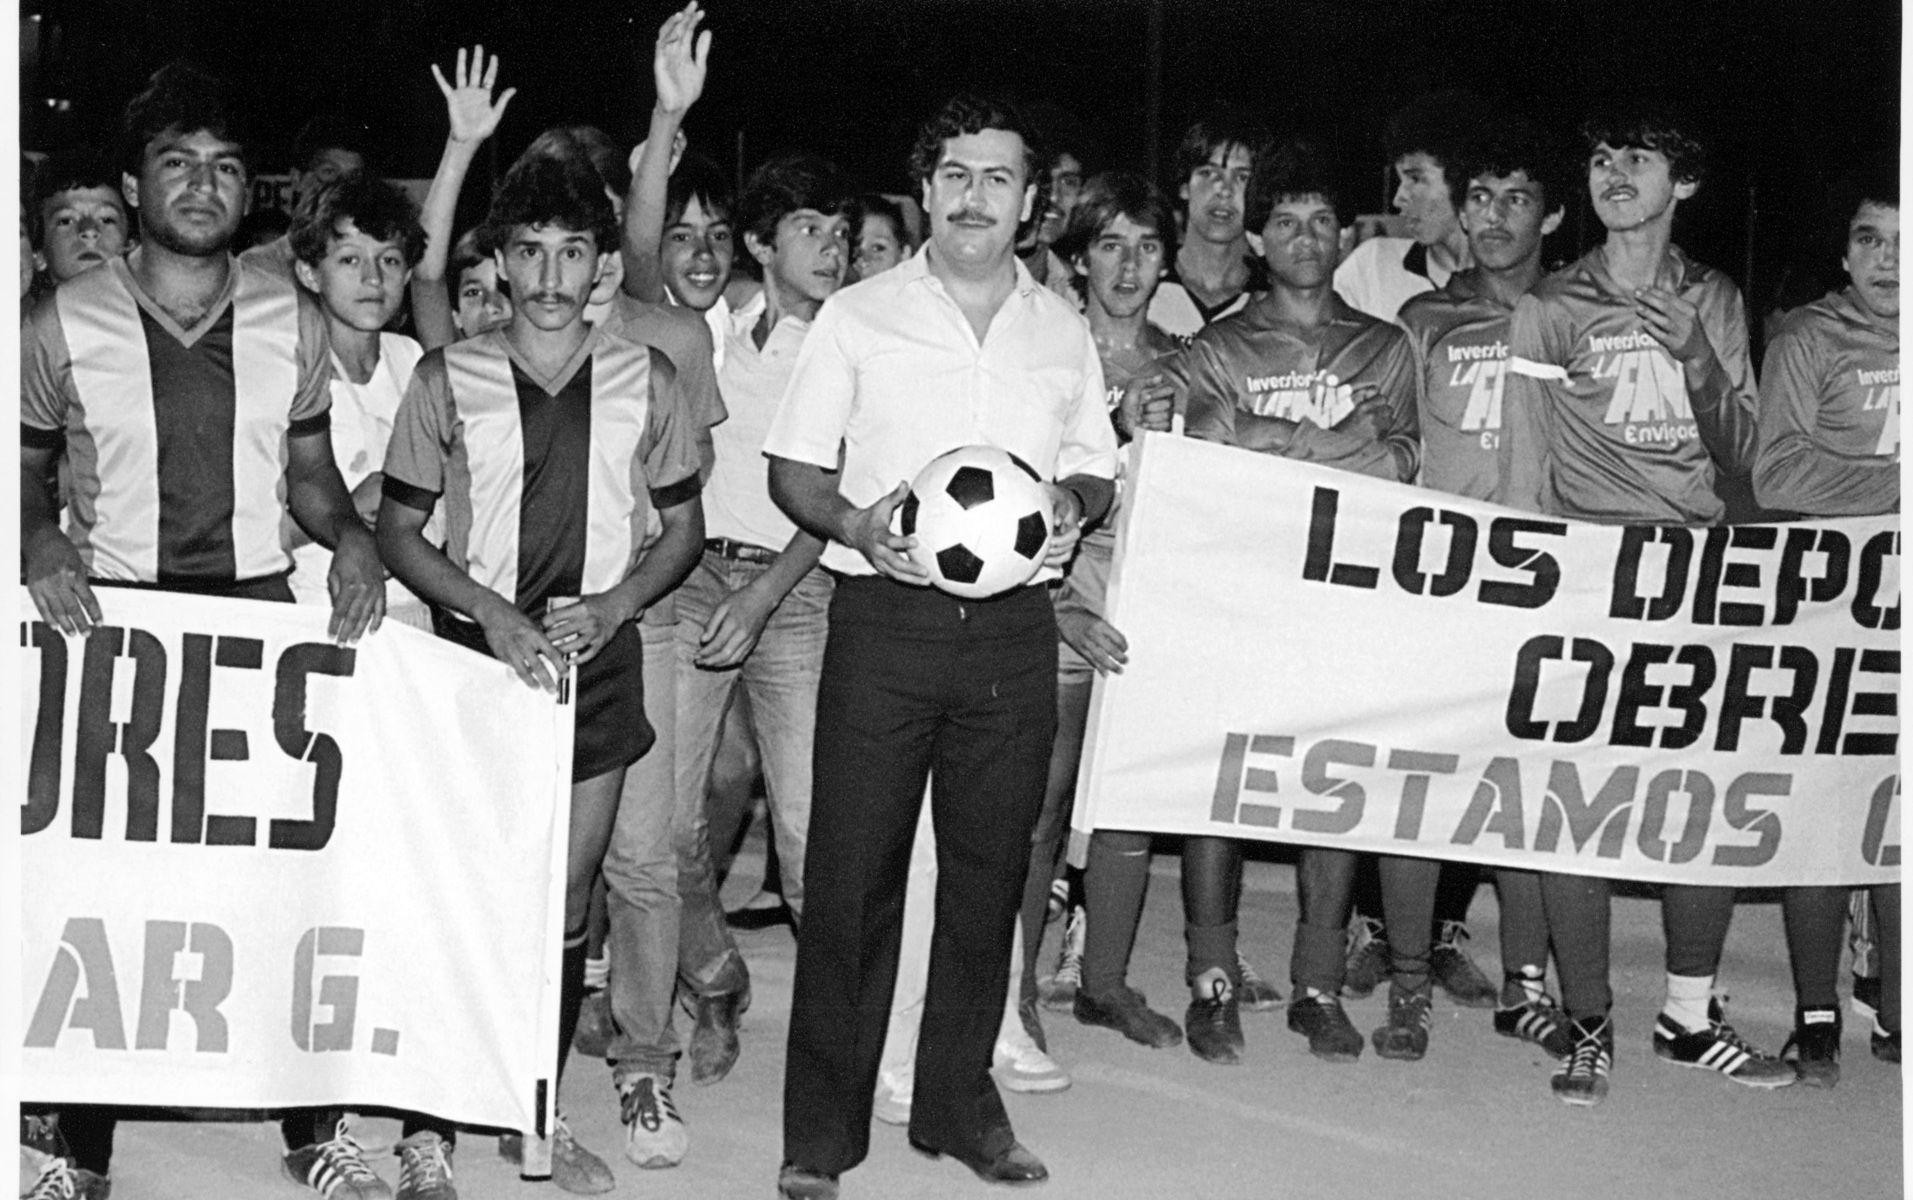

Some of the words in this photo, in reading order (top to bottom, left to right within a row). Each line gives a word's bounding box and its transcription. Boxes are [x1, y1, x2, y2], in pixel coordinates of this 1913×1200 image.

[1302, 486, 1567, 608] LOS
[1505, 634, 1899, 756] OBRE
[1209, 733, 1793, 867] ESTAMOS
[290, 926, 400, 1056] G.
